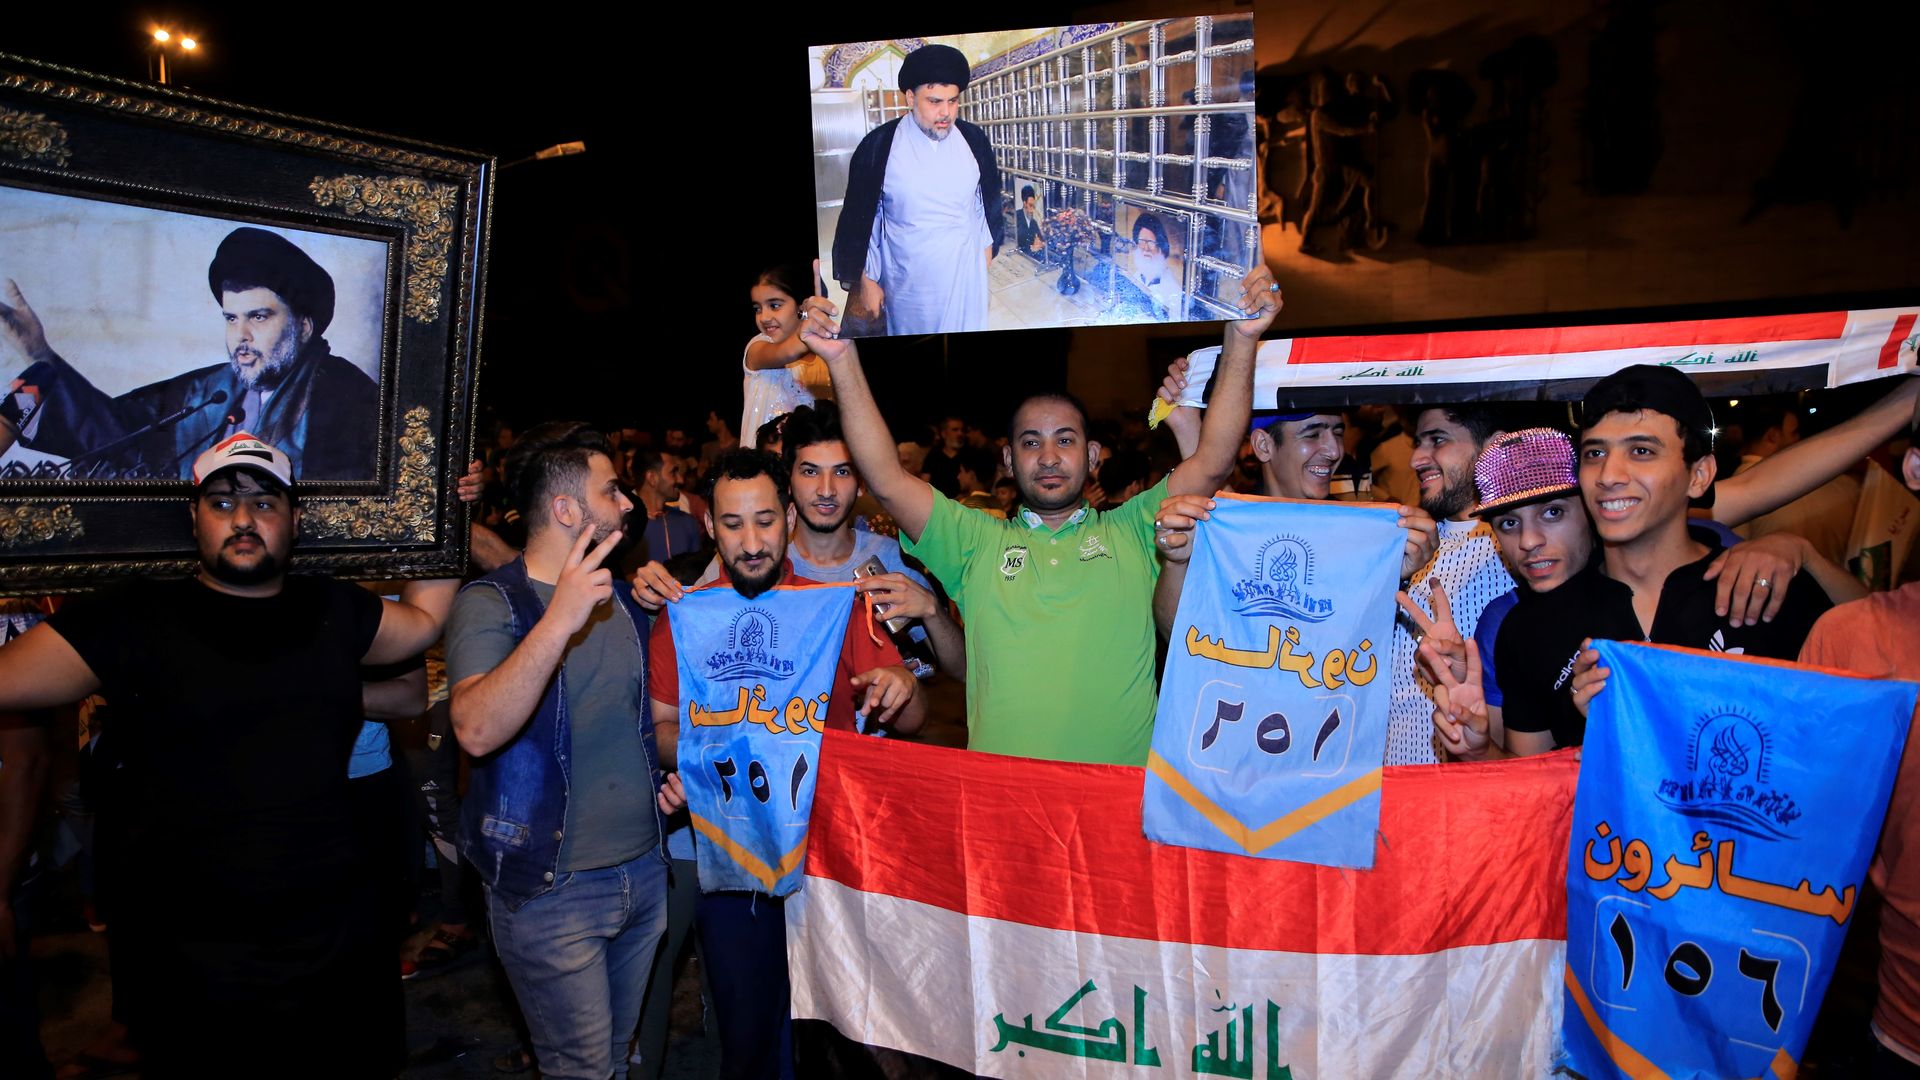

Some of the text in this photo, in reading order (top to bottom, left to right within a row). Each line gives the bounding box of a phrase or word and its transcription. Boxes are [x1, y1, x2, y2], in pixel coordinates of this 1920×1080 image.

[1004, 557, 1024, 569] MS
[1583, 820, 1857, 927] سائرون
[1191, 988, 1294, 1080] الله
